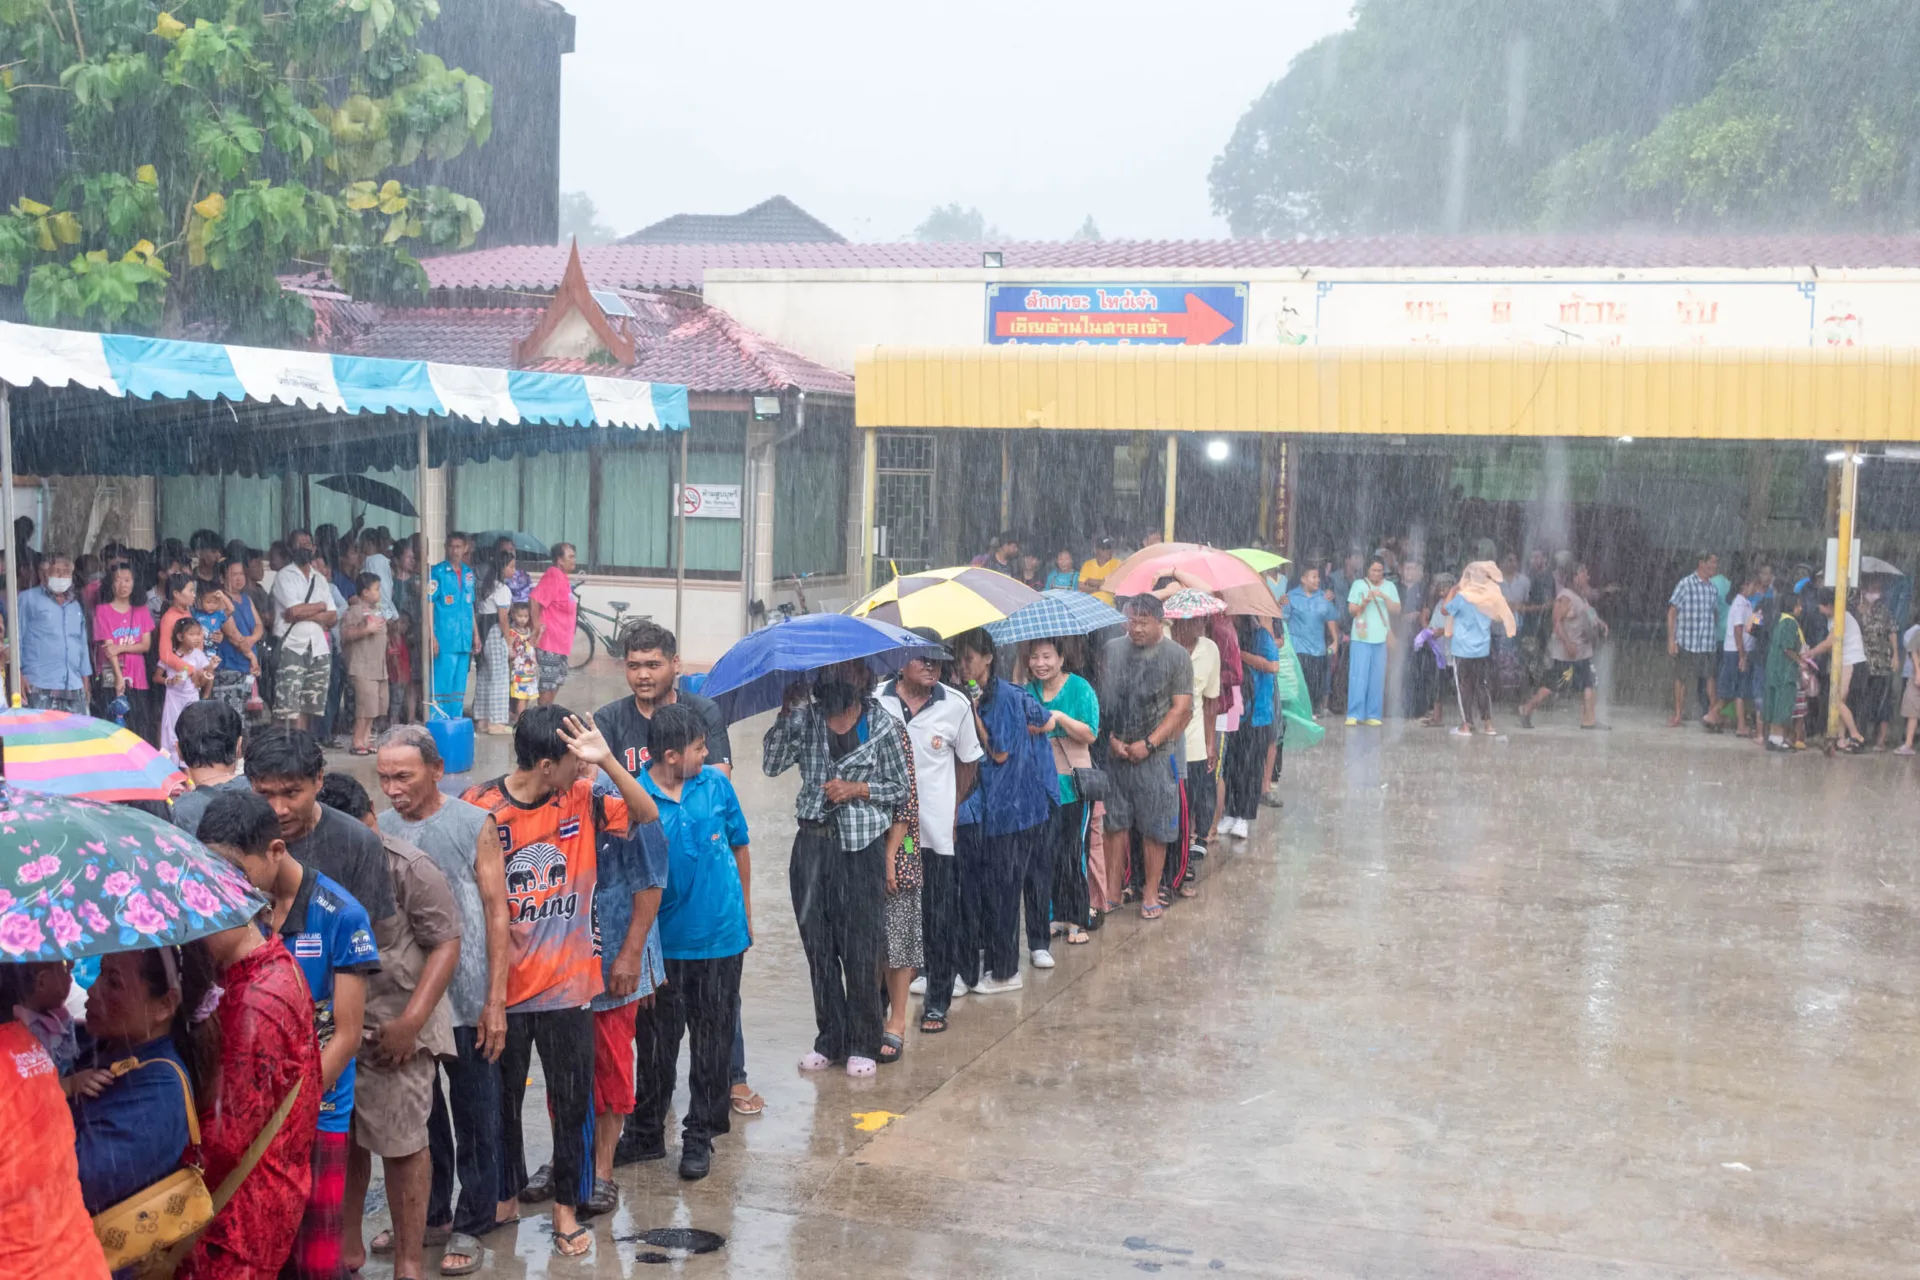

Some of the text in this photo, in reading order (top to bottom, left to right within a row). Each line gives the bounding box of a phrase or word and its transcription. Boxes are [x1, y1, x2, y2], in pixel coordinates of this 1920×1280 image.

[1025, 290, 1091, 309] สักการะ
[507, 892, 578, 924] Chang
[297, 932, 322, 940] THAILAND
